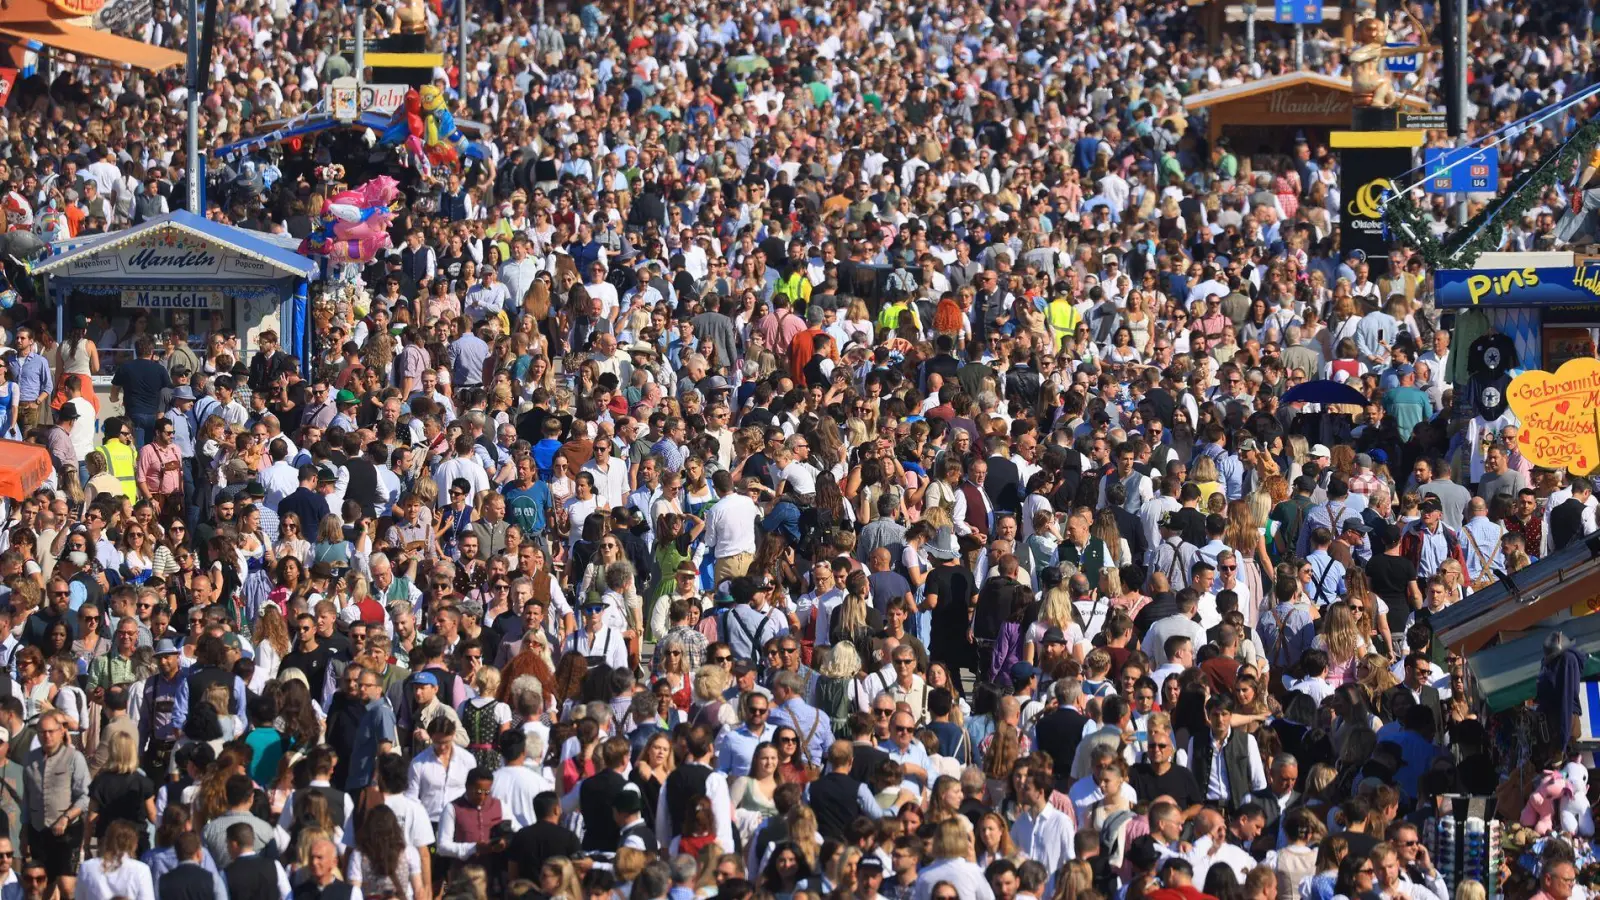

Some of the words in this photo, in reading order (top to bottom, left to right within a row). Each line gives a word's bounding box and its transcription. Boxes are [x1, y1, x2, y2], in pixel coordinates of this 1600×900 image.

[1474, 166, 1485, 174] U3
[1437, 179, 1448, 187] U5
[1473, 179, 1485, 187] U6
[74, 259, 111, 269] Magenbrot
[128, 248, 216, 272] Mandeln
[235, 259, 264, 270] Popcorn
[1467, 268, 1539, 304] Pins
[136, 292, 208, 308] Mandeln
[1520, 370, 1600, 400] Gebrannt
[1583, 390, 1600, 408] M
[1534, 436, 1582, 459] Para
